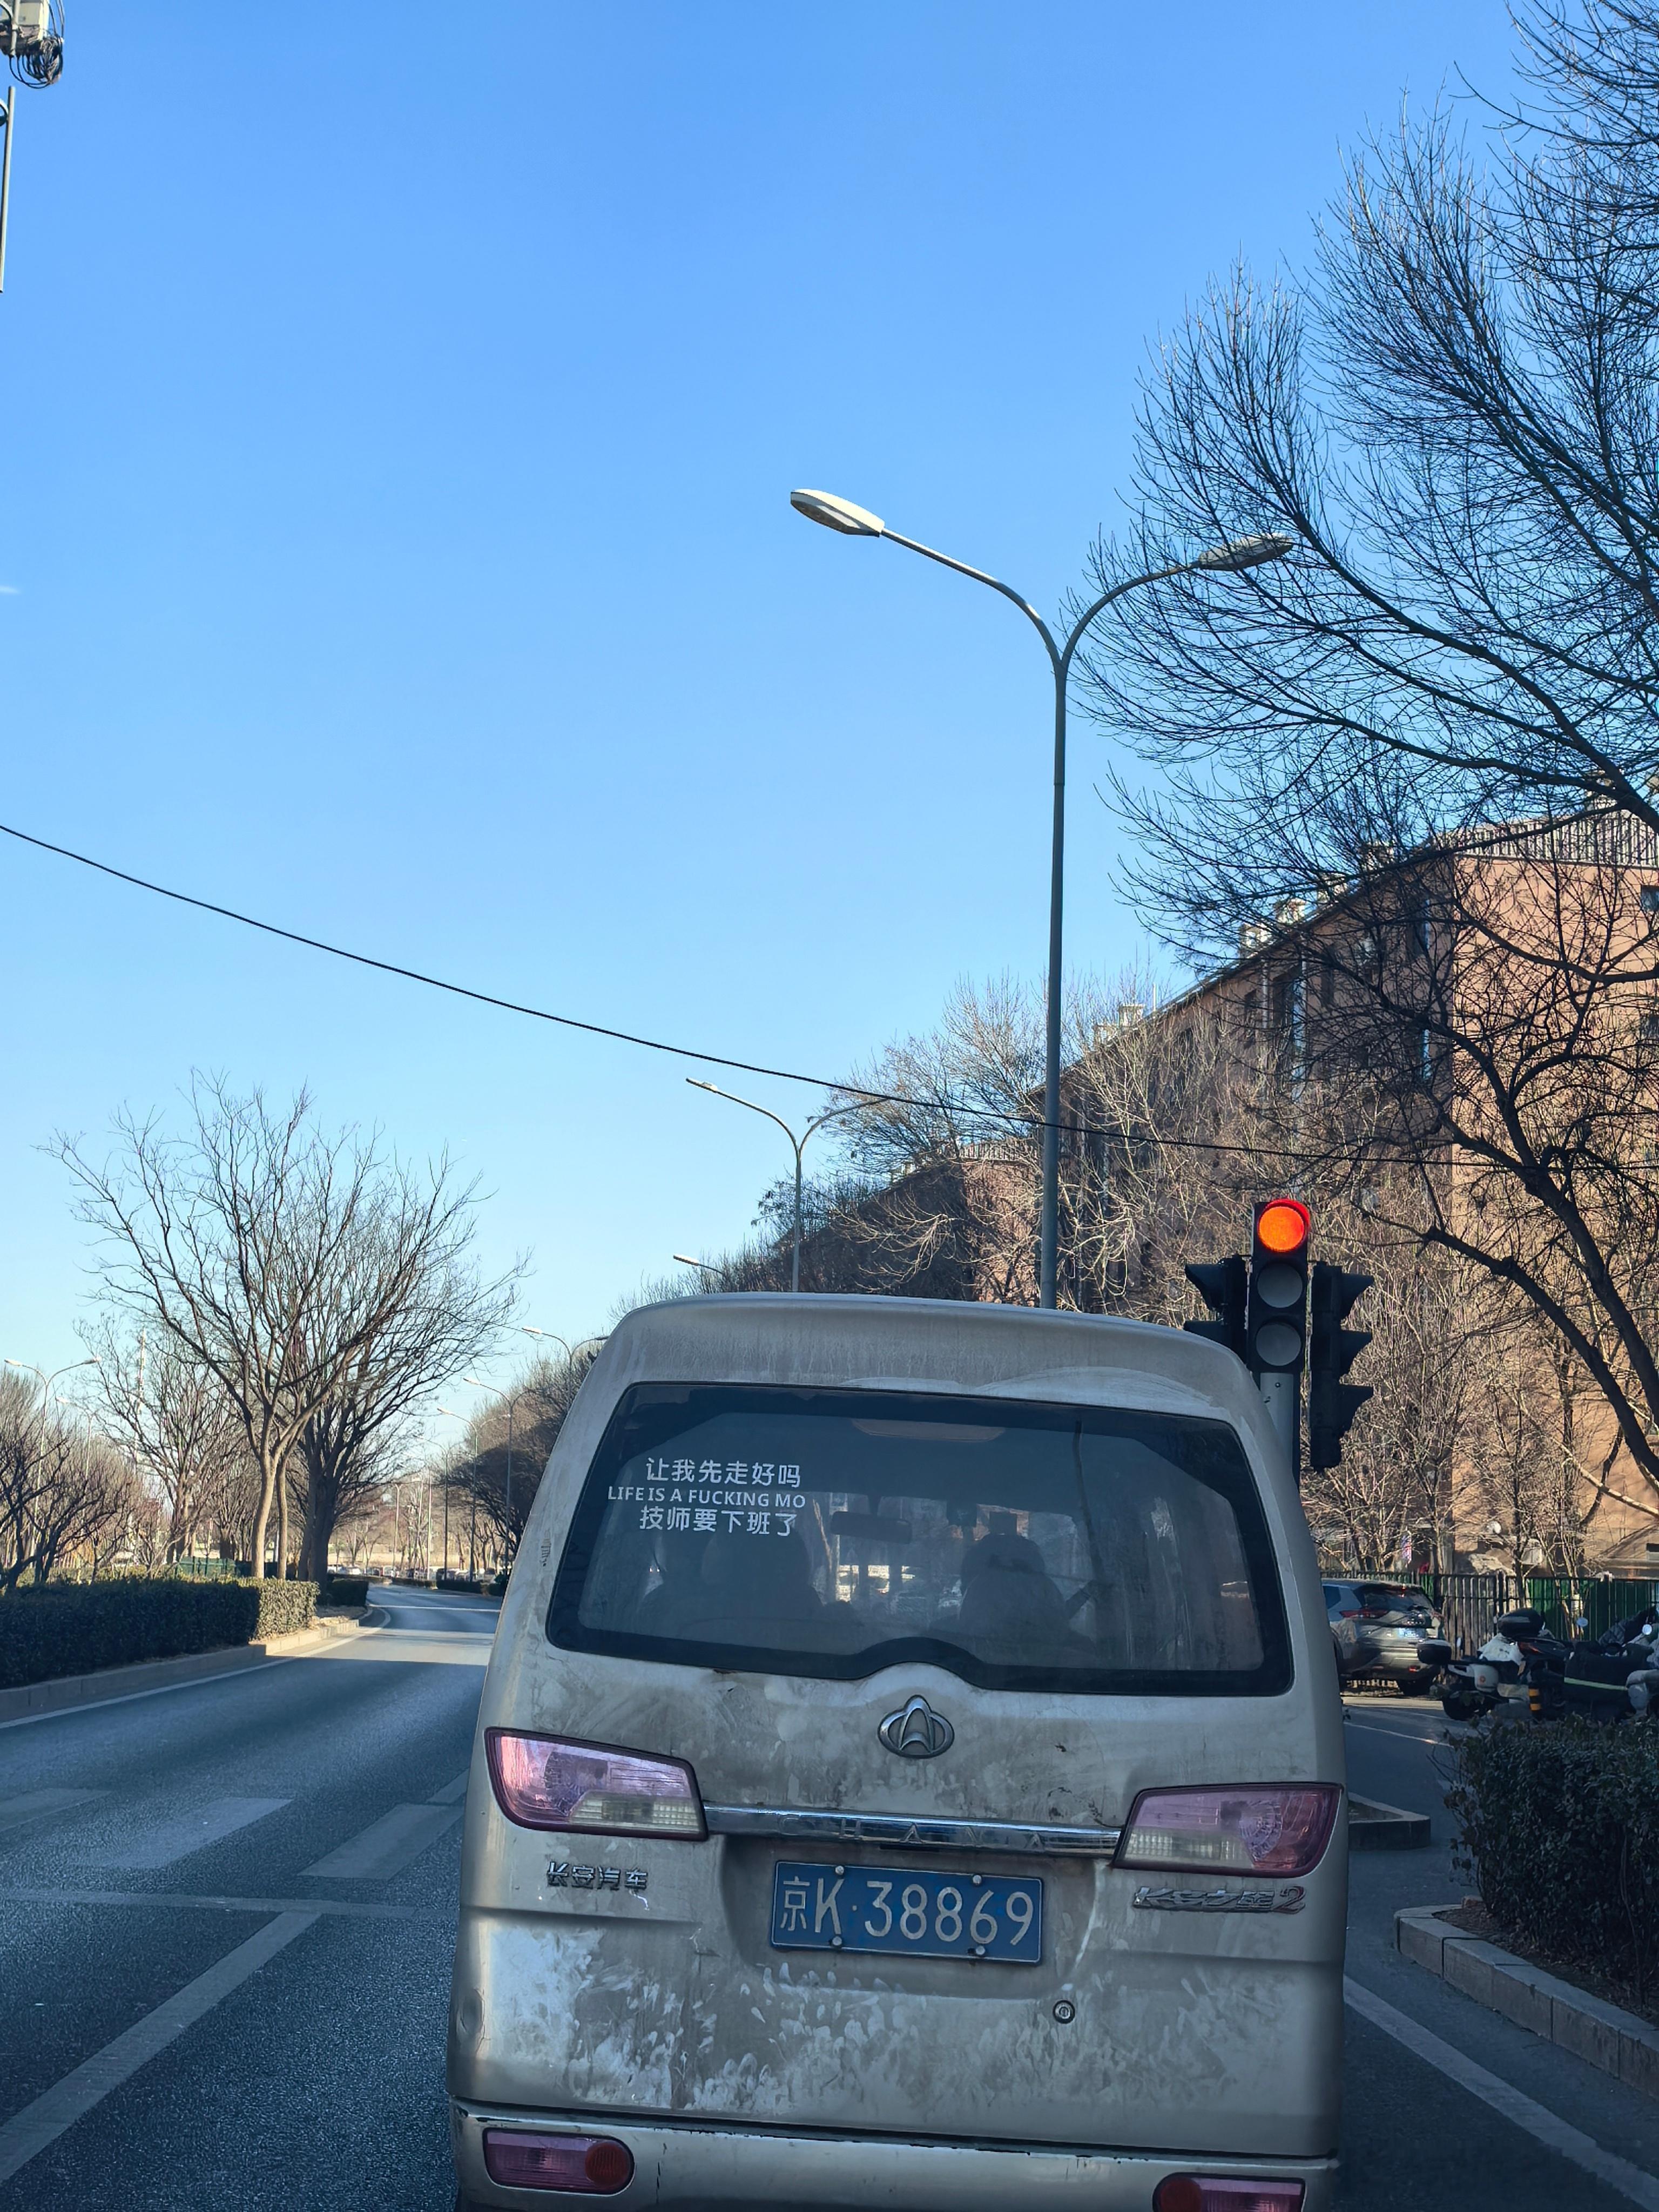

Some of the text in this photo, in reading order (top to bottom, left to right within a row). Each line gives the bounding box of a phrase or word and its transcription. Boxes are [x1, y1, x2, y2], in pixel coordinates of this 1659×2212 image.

[646, 1458, 800, 1488] 让我先走好吗
[608, 1486, 806, 1508] LIFE IS A FUCKING MO
[639, 1505, 798, 1537] 技师要下班了
[548, 1861, 648, 1891] 长安汽车
[780, 1876, 1034, 1945] 京K·38869
